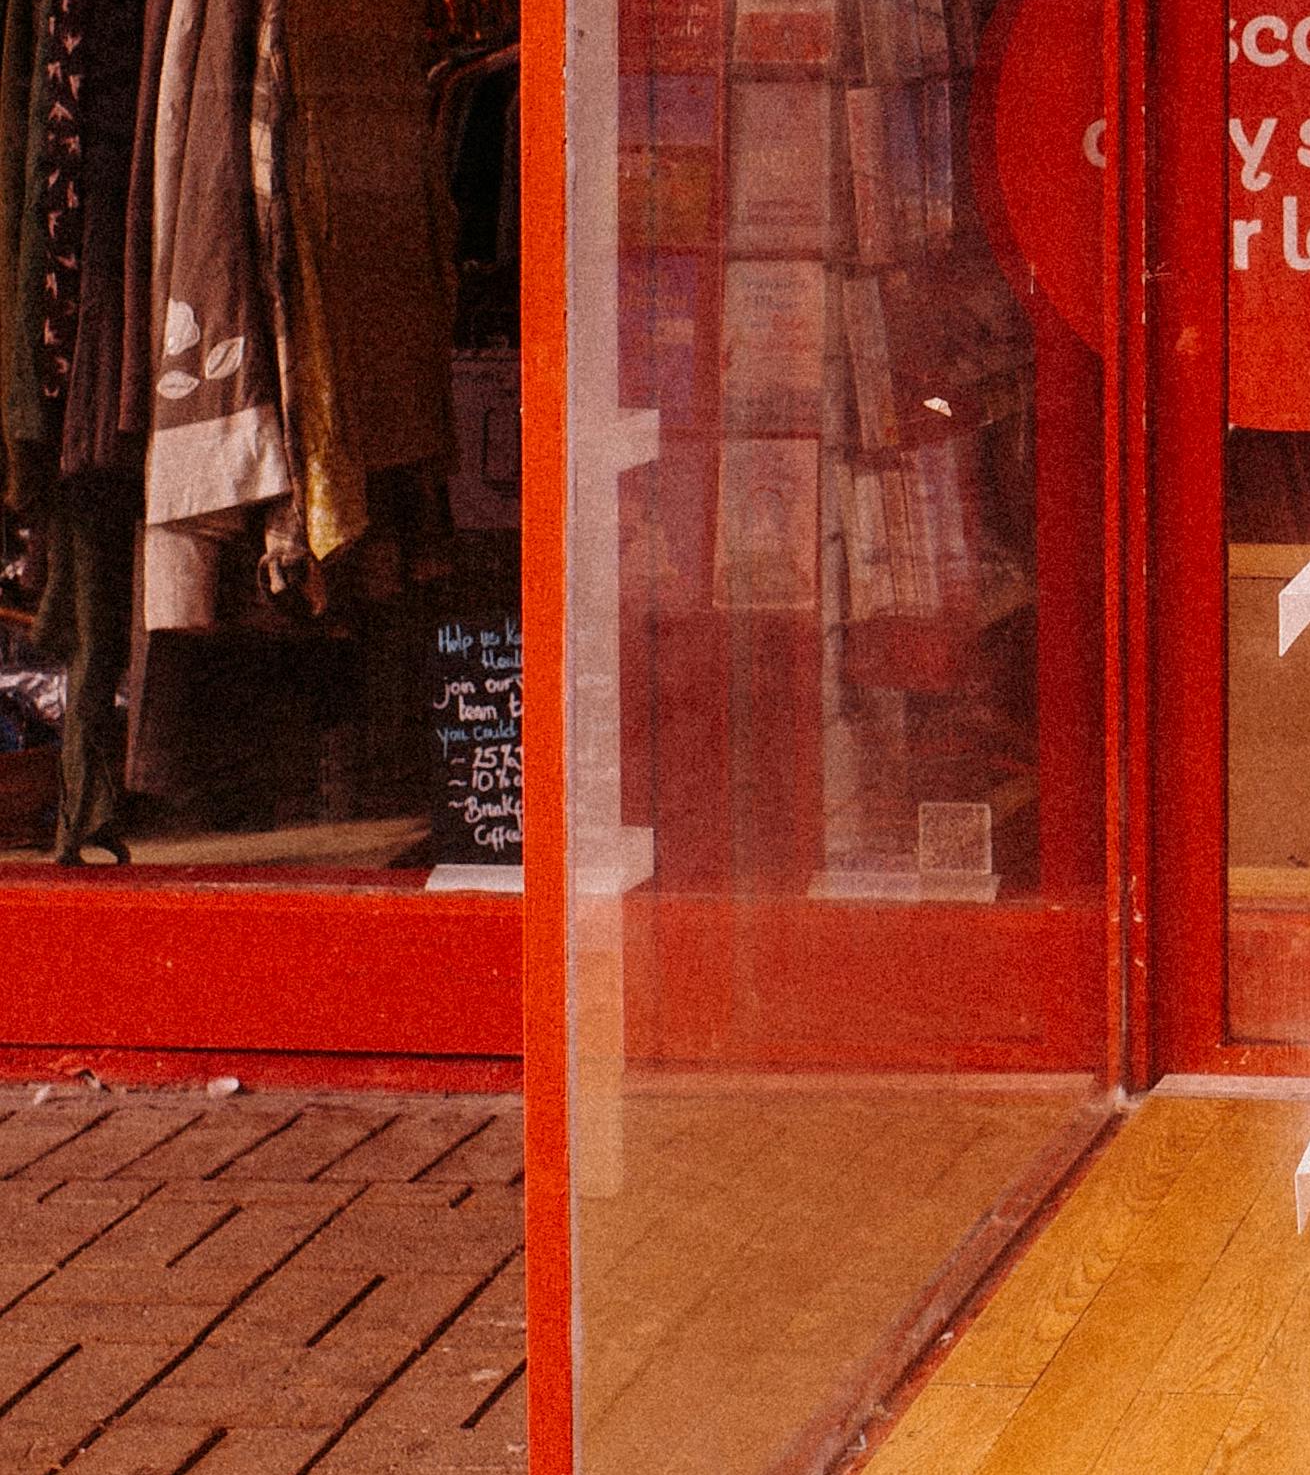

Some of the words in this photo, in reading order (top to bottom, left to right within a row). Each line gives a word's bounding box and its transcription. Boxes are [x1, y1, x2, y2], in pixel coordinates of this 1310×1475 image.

[438, 624, 474, 660] Help
[432, 675, 476, 710] join
[458, 693, 498, 722] team
[436, 725, 470, 761] you
